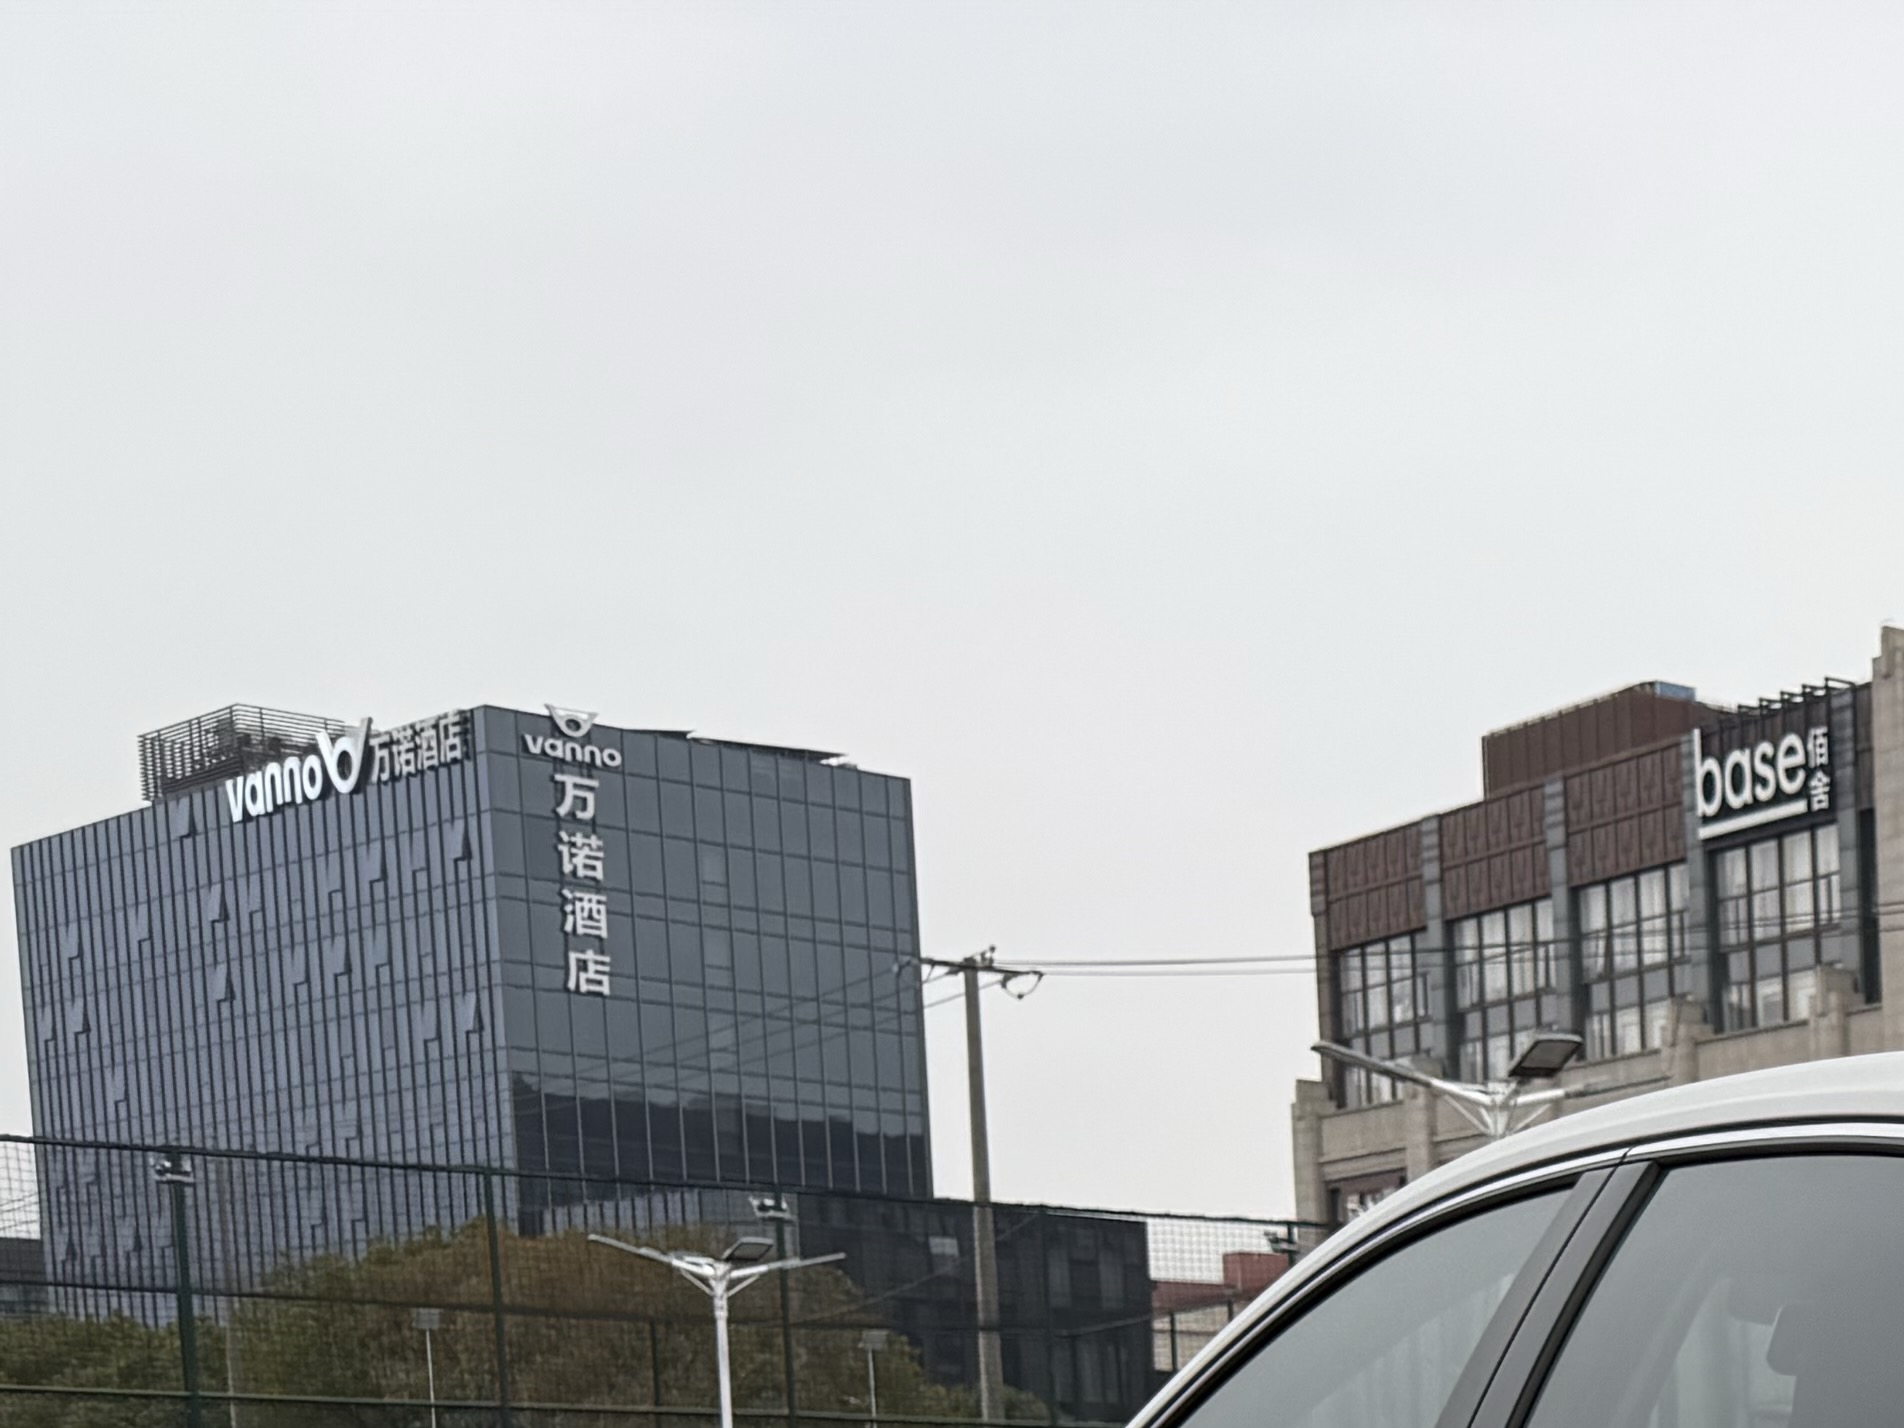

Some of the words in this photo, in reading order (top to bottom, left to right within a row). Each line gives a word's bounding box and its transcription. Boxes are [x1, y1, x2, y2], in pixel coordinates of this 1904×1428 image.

[368, 710, 465, 784] 万诺酒店
[523, 732, 623, 768] vanno
[1694, 728, 1806, 817] base
[1807, 726, 1831, 812] 佰舍
[225, 756, 323, 823] vanno
[554, 773, 612, 997] 万诺酒店
